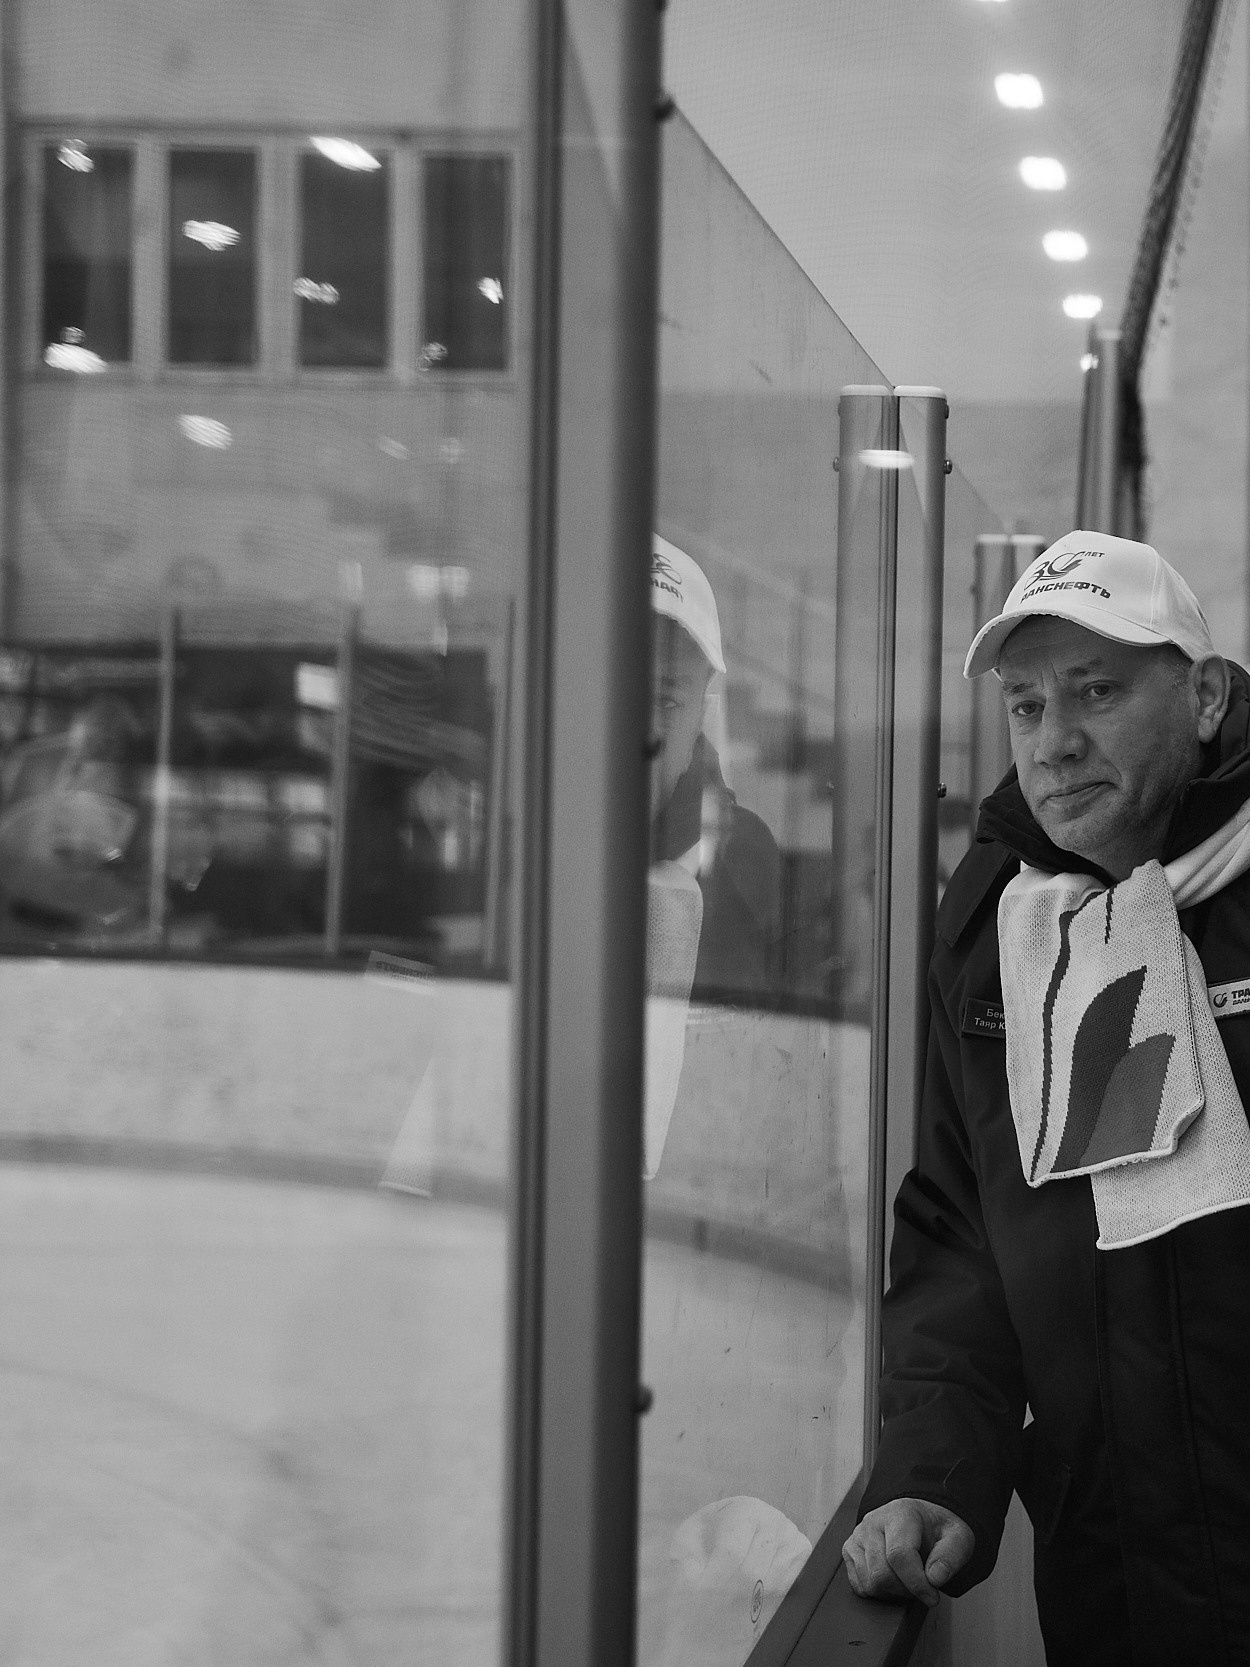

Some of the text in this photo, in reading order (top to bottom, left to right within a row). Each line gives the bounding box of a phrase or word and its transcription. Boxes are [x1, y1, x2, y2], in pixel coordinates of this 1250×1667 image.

[1020, 581, 1111, 604] РАНСНЕФТЬ
[986, 1008, 1005, 1019] Бек
[974, 1017, 1005, 1030] Таяр К
